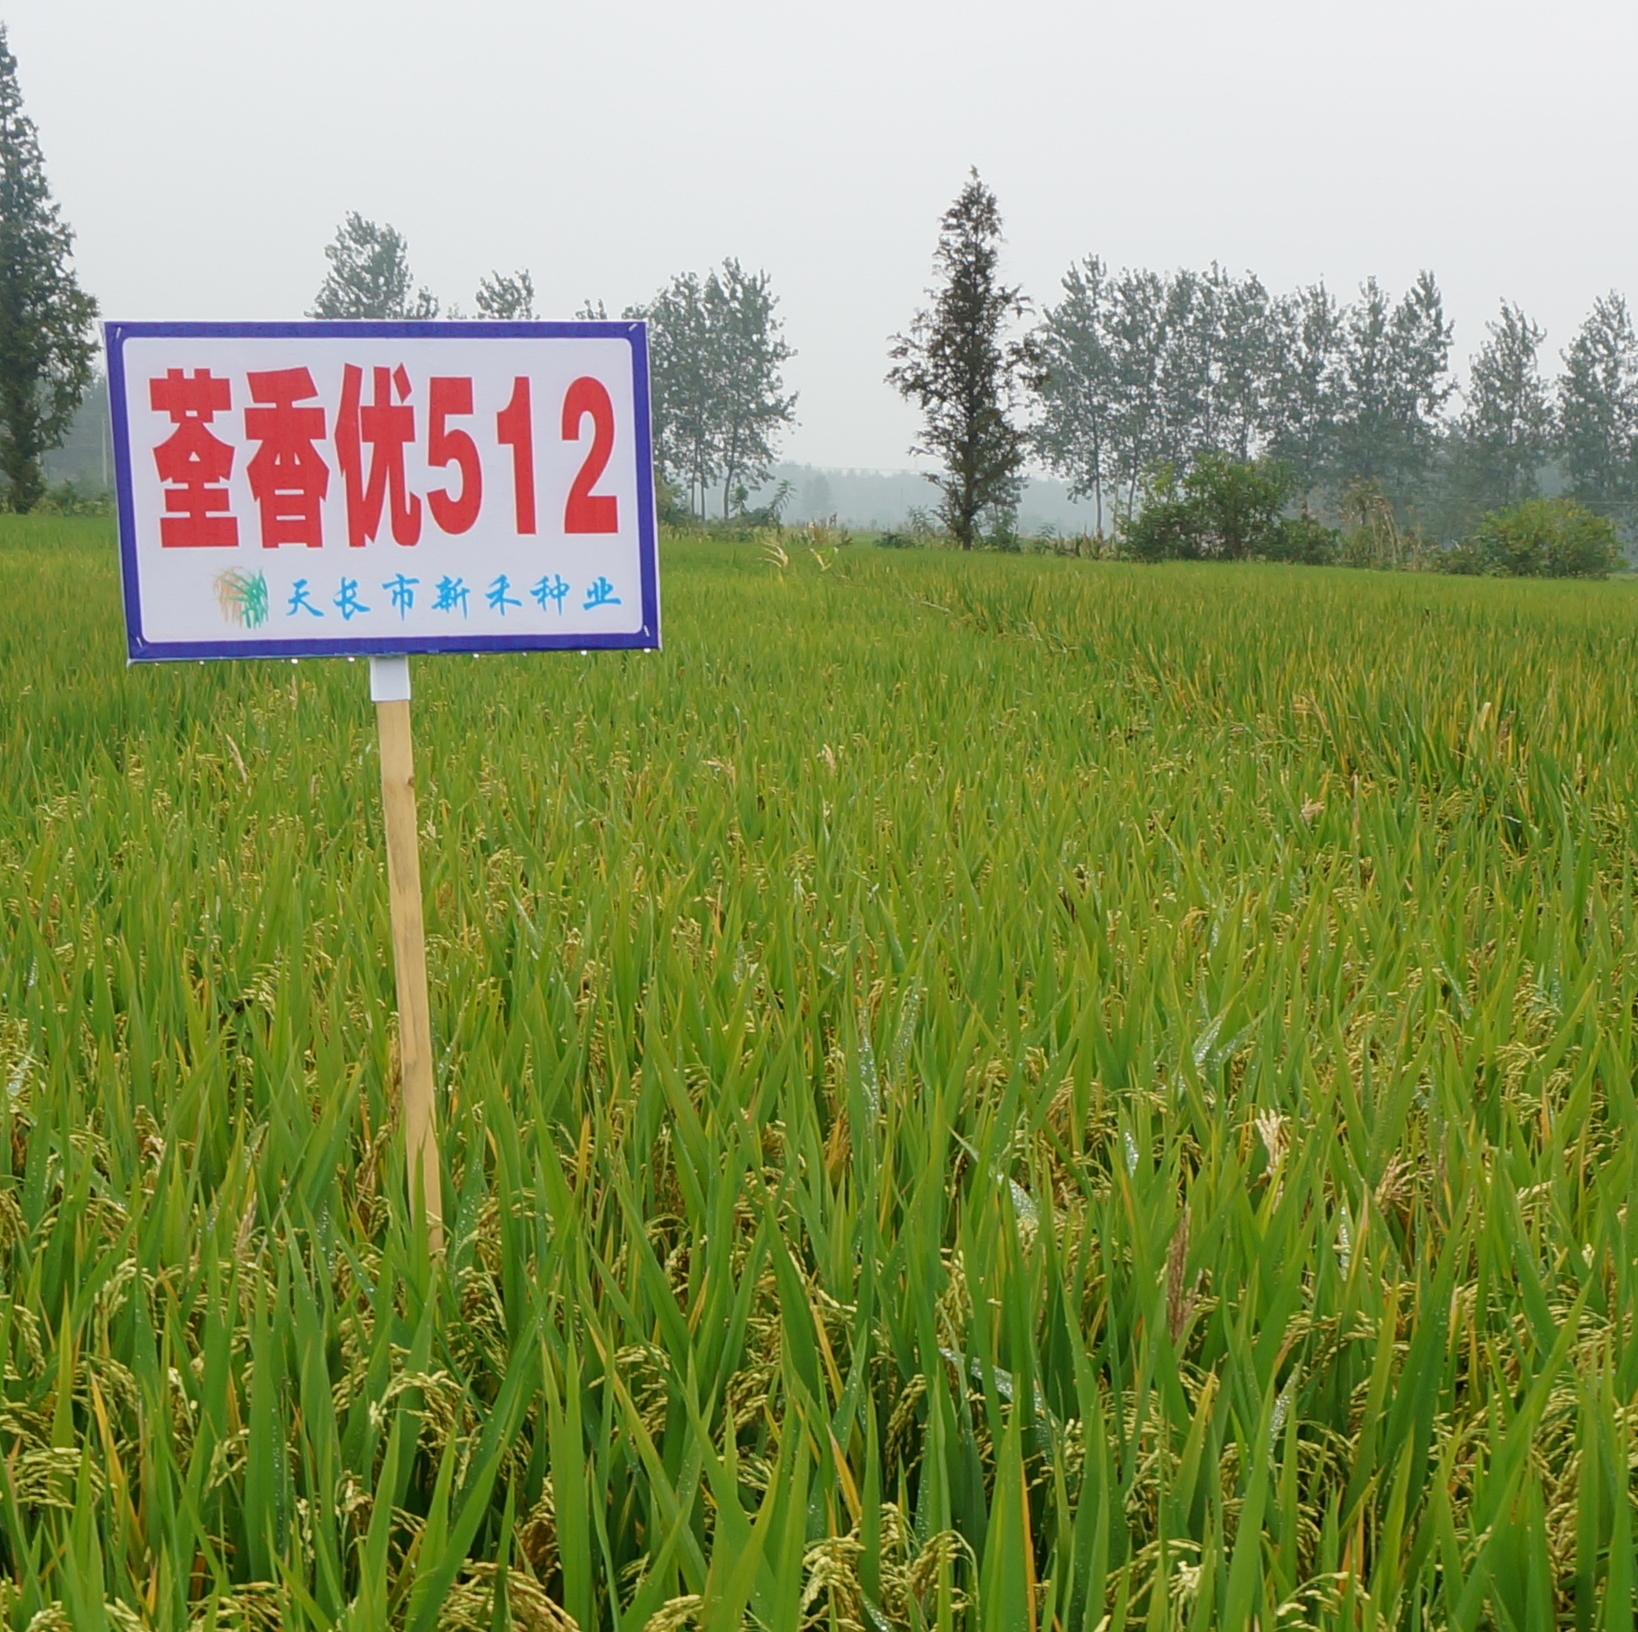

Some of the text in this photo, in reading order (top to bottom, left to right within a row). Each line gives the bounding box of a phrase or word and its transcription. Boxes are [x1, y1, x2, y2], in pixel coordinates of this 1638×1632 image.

[149, 363, 619, 549] 荃香优512
[285, 573, 623, 621] 天长市新禾种业
